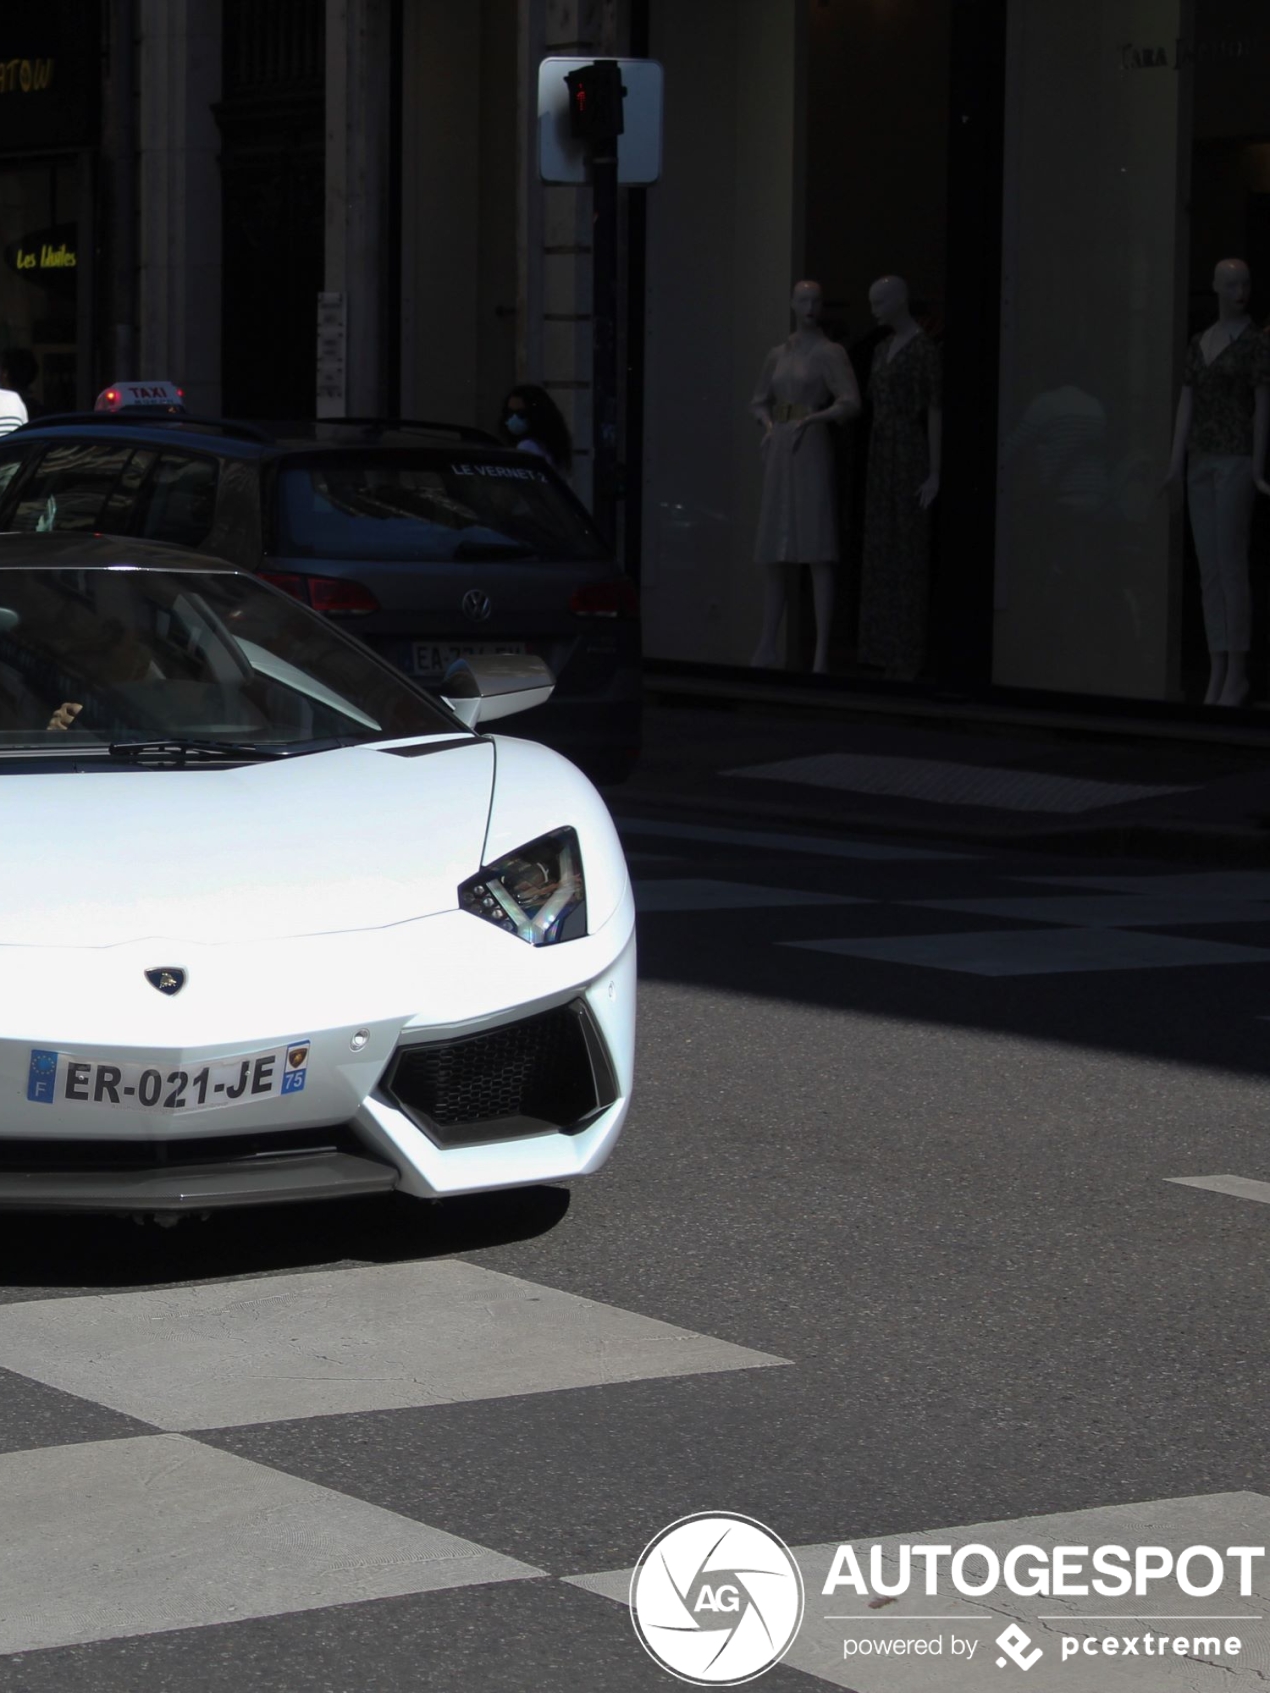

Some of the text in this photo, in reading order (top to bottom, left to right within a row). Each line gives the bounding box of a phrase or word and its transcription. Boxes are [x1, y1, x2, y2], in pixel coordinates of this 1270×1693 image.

[16, 248, 36, 270] Les
[128, 387, 167, 398] TAXI
[451, 464, 474, 476] LE
[474, 465, 535, 480] VERNET
[35, 1081, 46, 1096] F
[65, 1055, 276, 1108] ER-021-JE
[285, 1071, 303, 1089] 75
